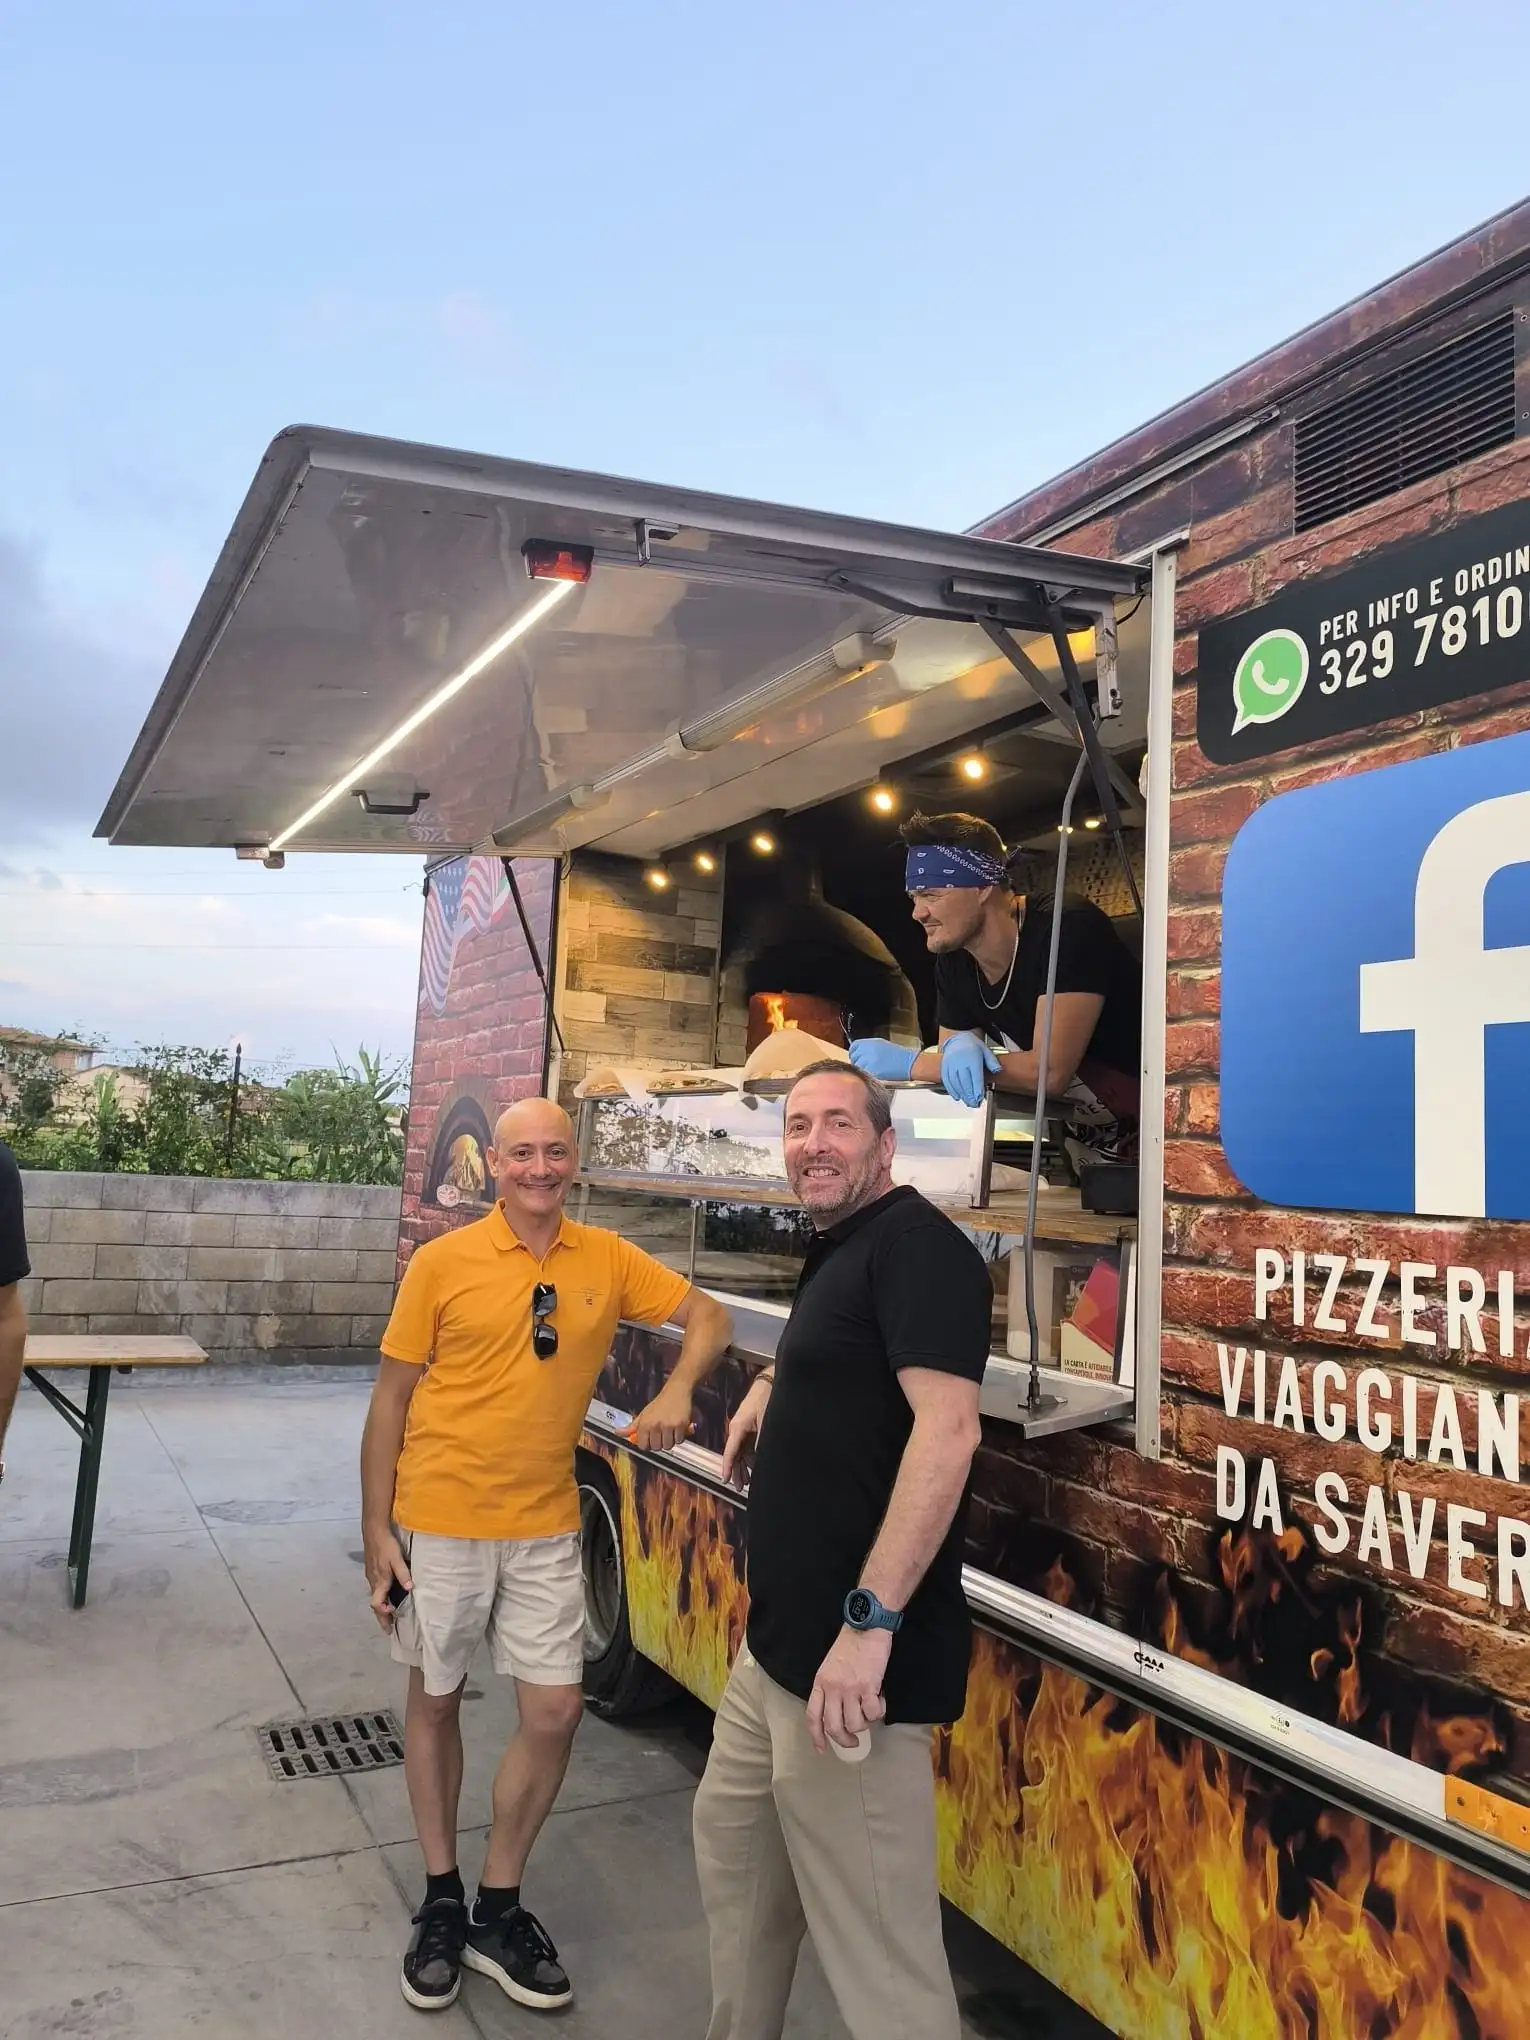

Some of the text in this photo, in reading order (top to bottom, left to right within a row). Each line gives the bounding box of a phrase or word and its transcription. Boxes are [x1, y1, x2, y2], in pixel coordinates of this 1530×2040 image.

[1319, 545, 1530, 645] PER INFO E ORDIN
[1319, 585, 1530, 695] 329 7810
[1255, 1248, 1530, 1361] PIZZERI
[1216, 1343, 1520, 1483] VIAGGIAN
[1216, 1445, 1530, 1612] DA SAVER
